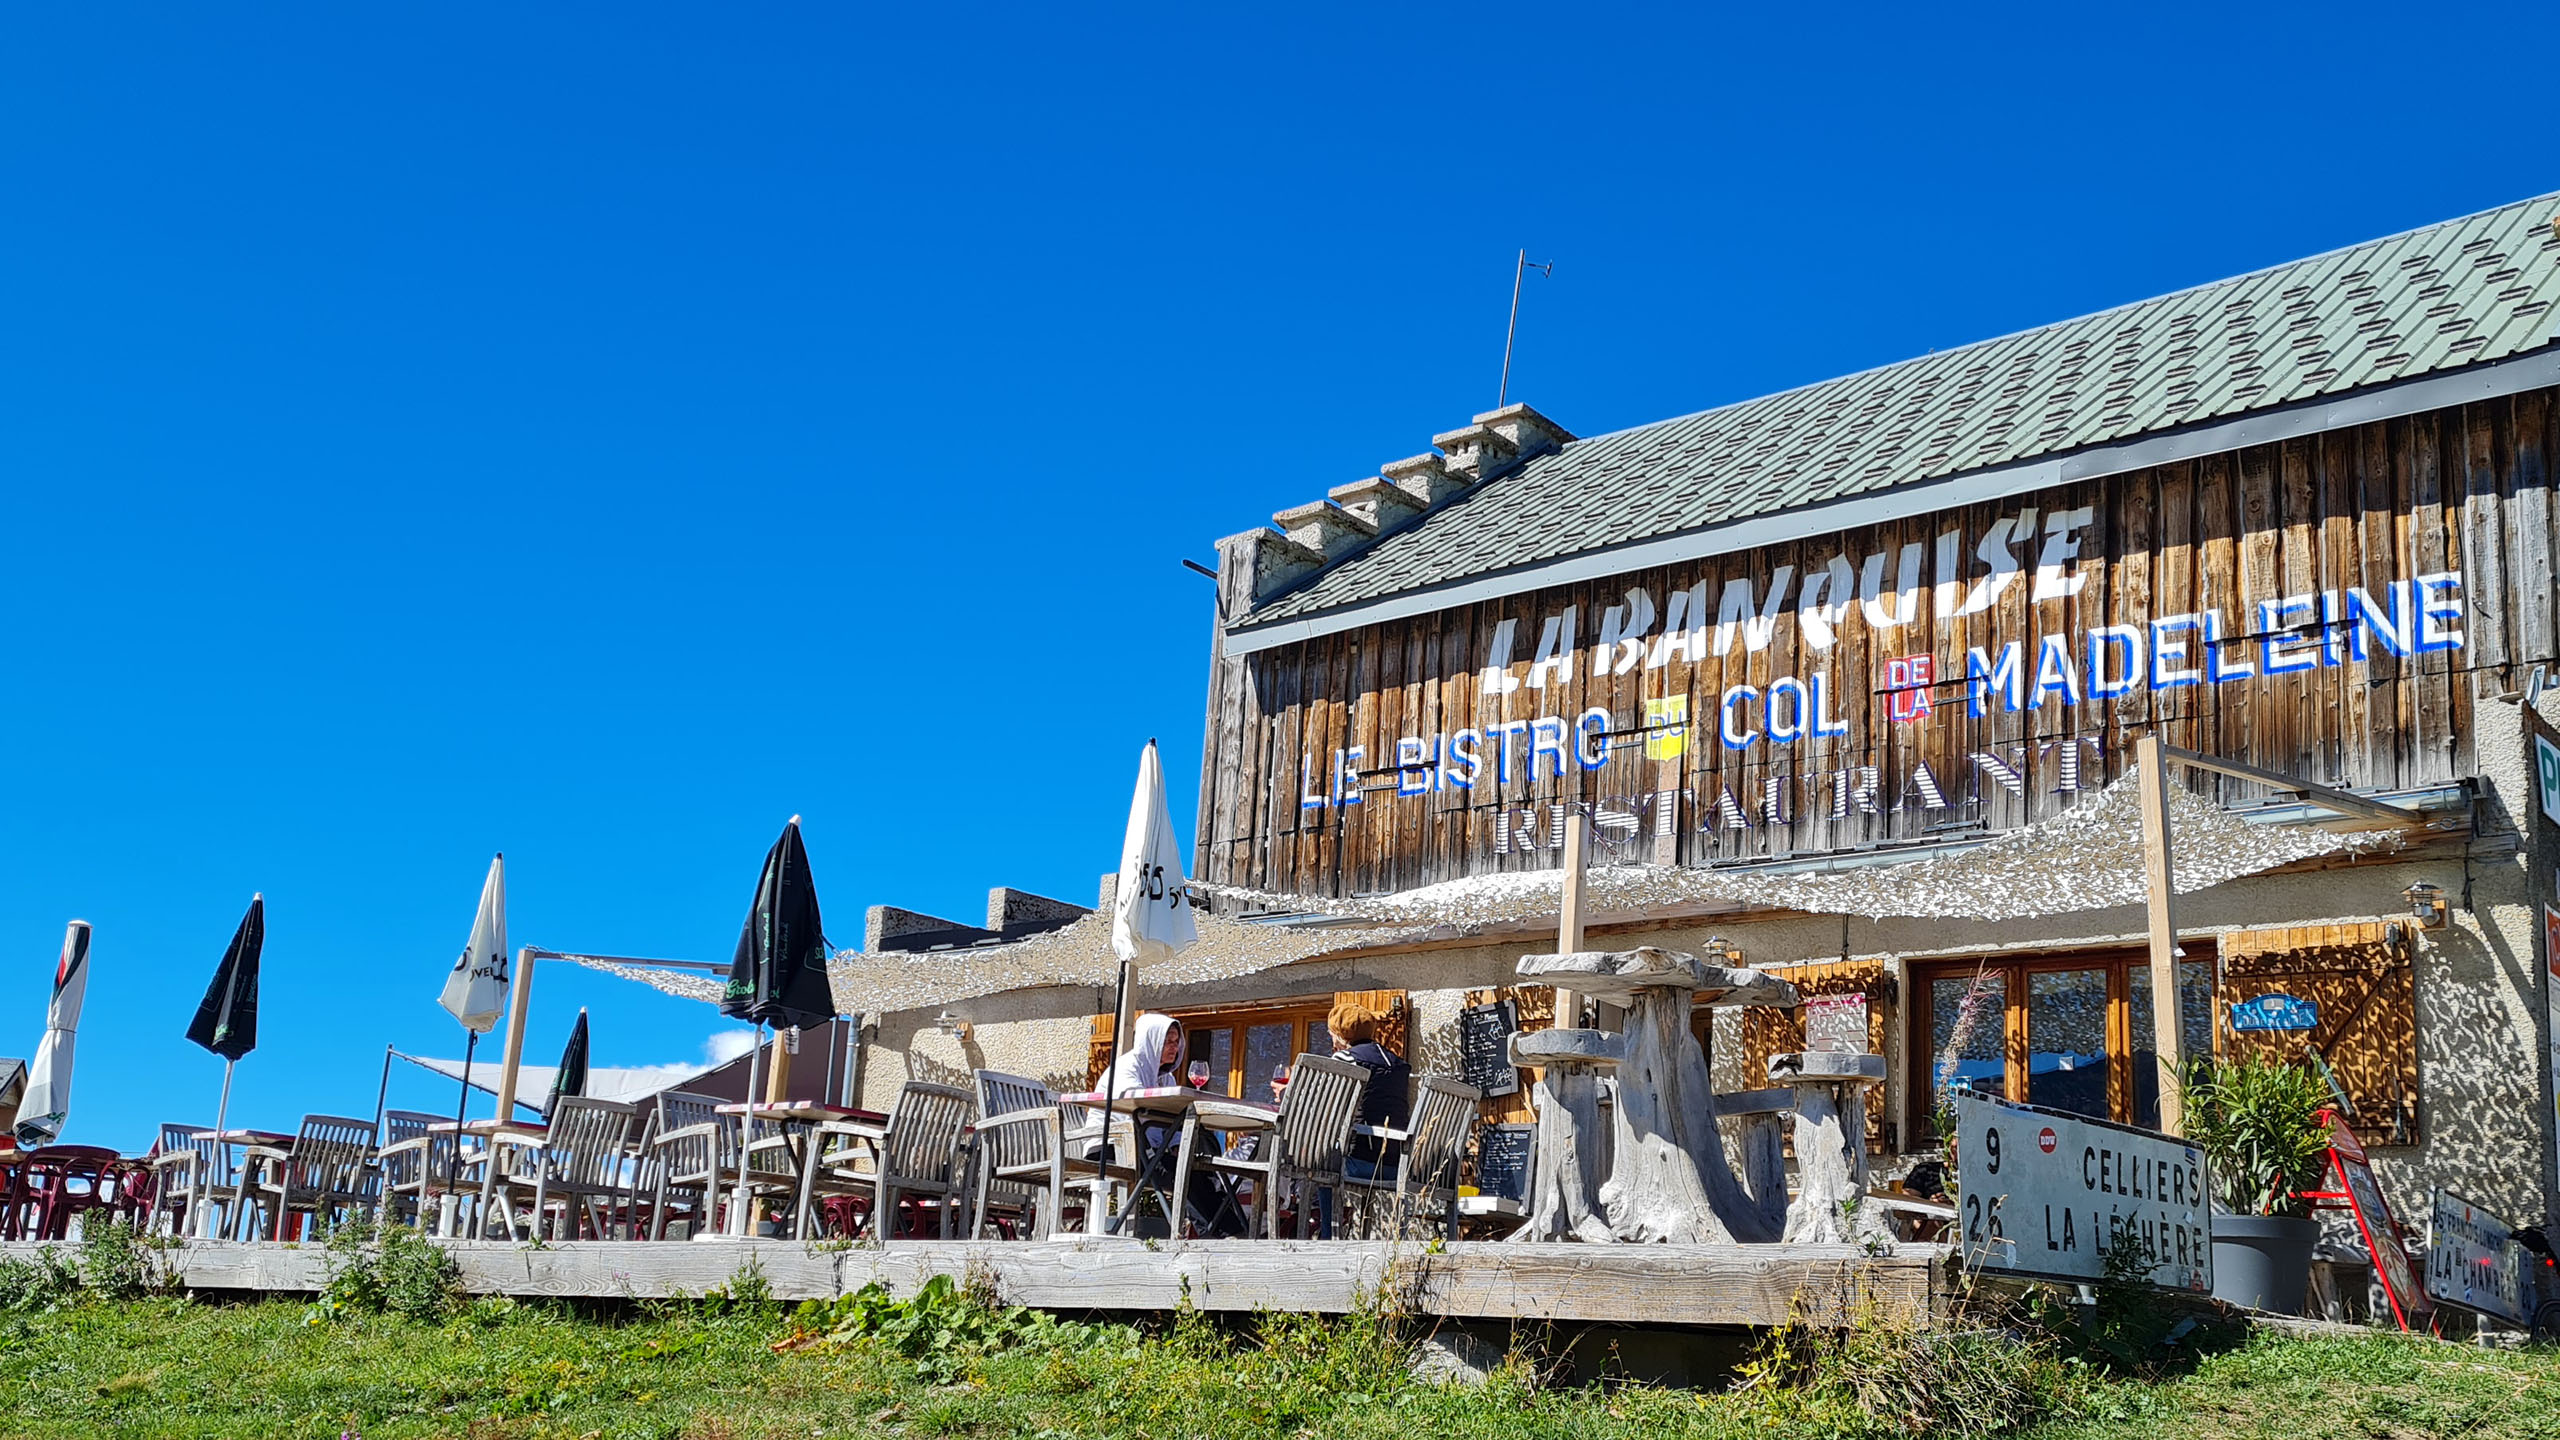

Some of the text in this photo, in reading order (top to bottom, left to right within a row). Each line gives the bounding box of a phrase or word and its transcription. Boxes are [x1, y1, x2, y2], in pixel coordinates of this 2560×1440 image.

[1482, 505, 2095, 694] LA BANQUISE
[1302, 570, 2465, 809] LE BISTRO DU COL DE LA MADELEINE
[1985, 1127, 2201, 1208] 9 CELLIERS
[1966, 1193, 2003, 1244] 26
[2045, 1204, 2077, 1253] LA
[2434, 1247, 2452, 1281] LA
